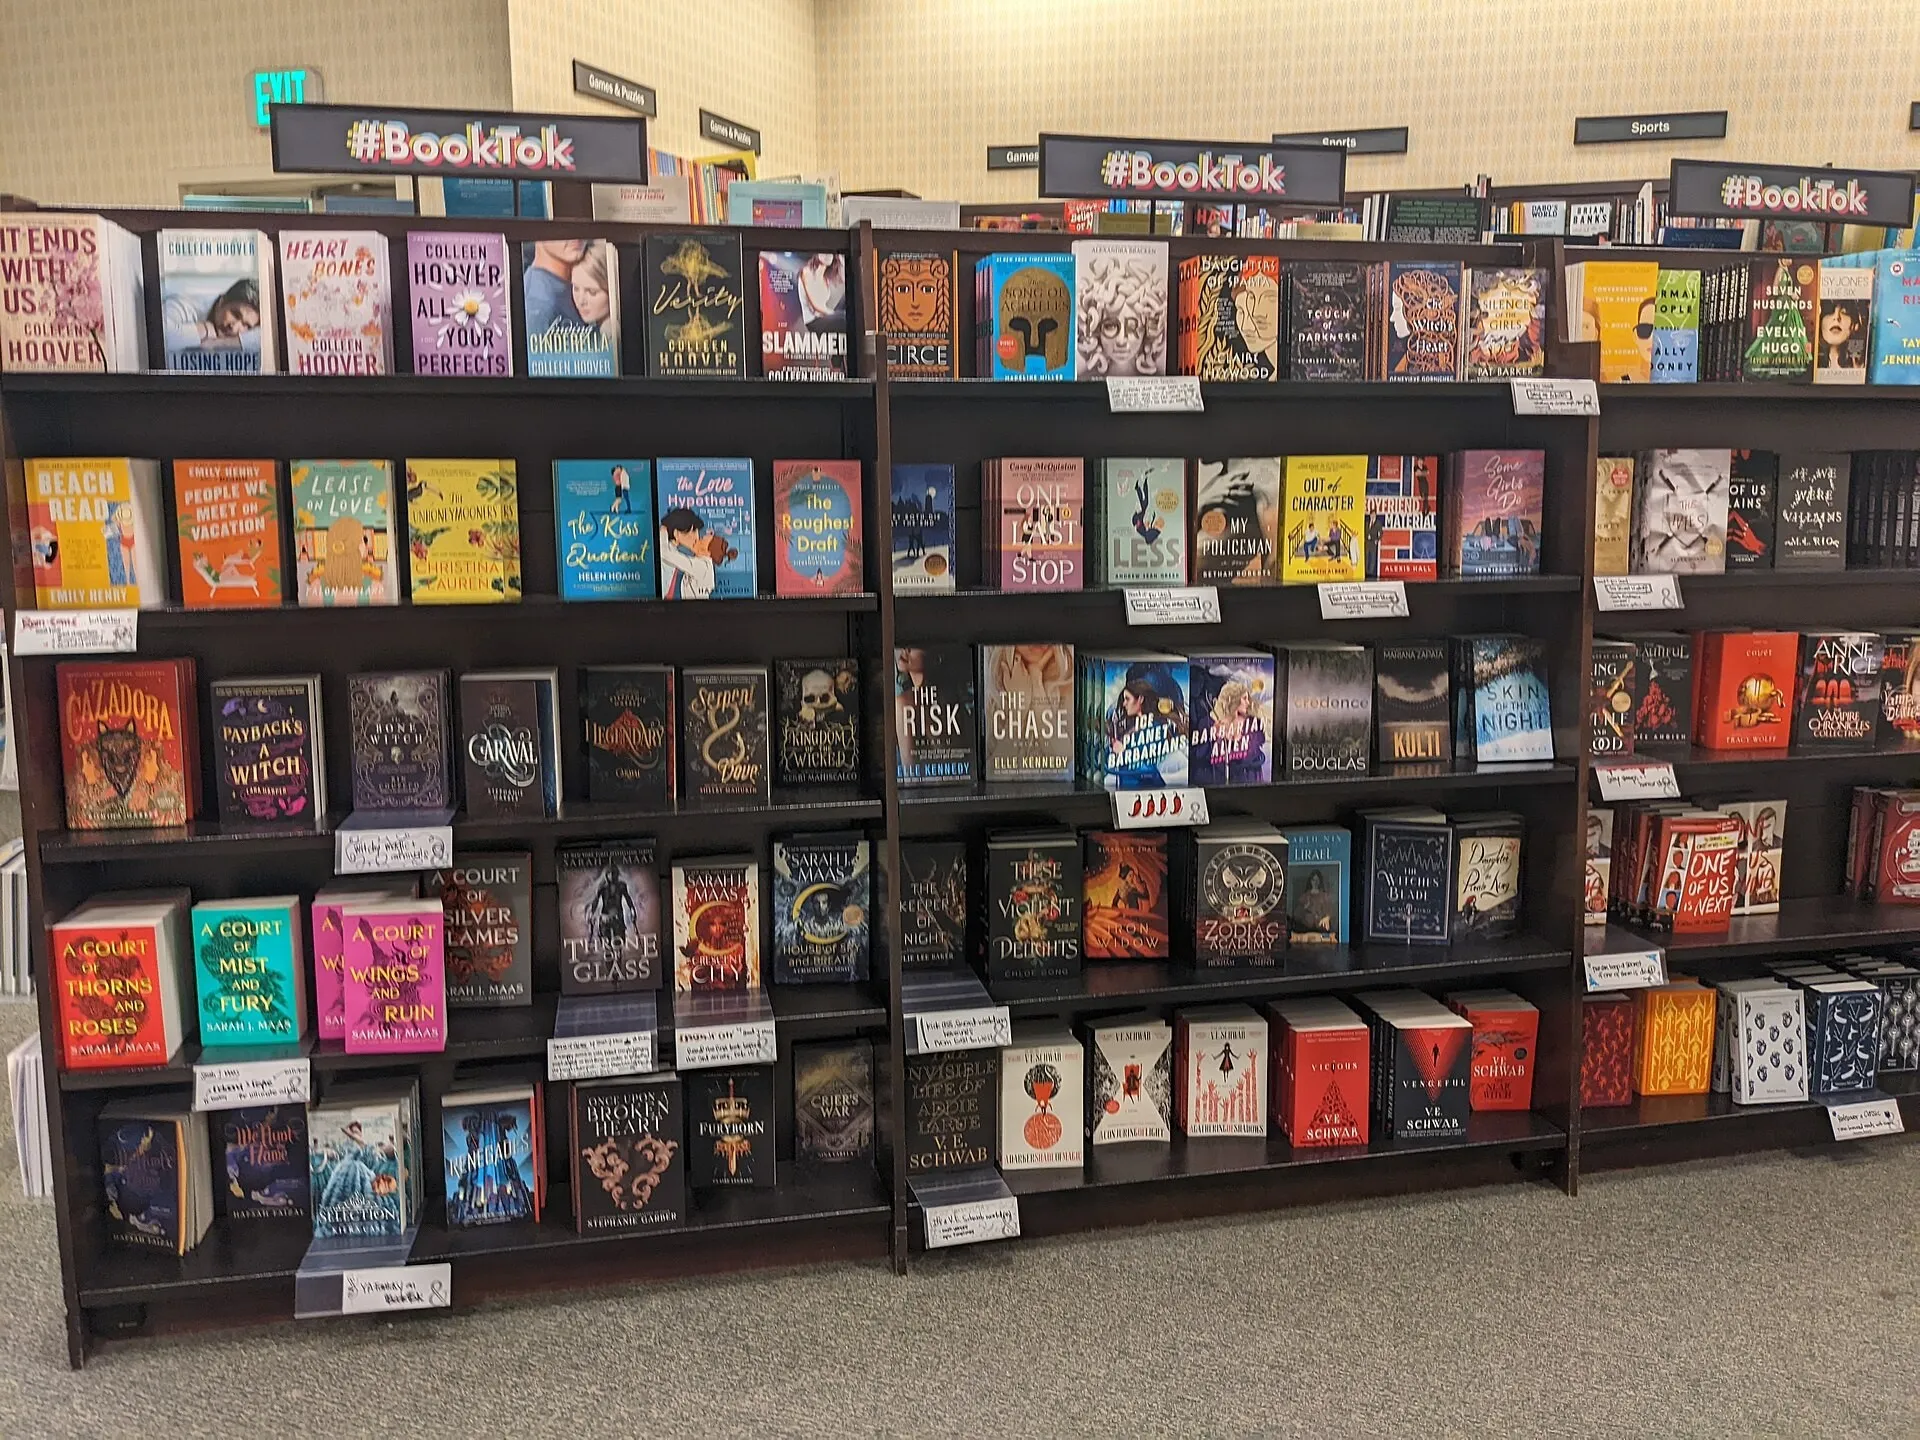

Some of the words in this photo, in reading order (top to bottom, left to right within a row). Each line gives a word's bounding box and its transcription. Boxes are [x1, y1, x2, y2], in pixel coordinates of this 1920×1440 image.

[589, 74, 613, 94] Games
[614, 85, 621, 98] &
[621, 85, 645, 106] Puzzles
[709, 119, 728, 138] Games
[728, 130, 733, 140] &
[1631, 119, 1670, 134] Sports
[347, 120, 576, 170] #BookTok
[1006, 151, 1039, 164] Games
[1101, 150, 1286, 194] #BookTok
[1721, 175, 1869, 215] #BookTok
[0, 228, 19, 254] IT
[28, 228, 97, 255] ENDS
[286, 239, 349, 261] HEART
[425, 244, 487, 260] COLLEEN
[1, 258, 67, 285] WITH
[314, 259, 376, 279] BONES
[414, 263, 502, 287] HOOVER
[1202, 259, 1276, 273] DAUGHTERS
[1766, 285, 1802, 296] SEVEN
[3, 289, 37, 315] US
[417, 298, 451, 319] ALL
[652, 283, 743, 320] Verity
[1483, 299, 1529, 310] SILENCE
[1753, 299, 1813, 310] HUSBANDS
[1489, 320, 1522, 331] GIRLS
[1756, 326, 1806, 337] EVELYN
[312, 338, 363, 353] COLLEEN
[446, 328, 495, 349] YOUR
[762, 332, 848, 356] SLAMMED
[1761, 342, 1800, 354] HUGO
[173, 353, 221, 371] LOSING
[226, 353, 259, 371] HOPE
[297, 353, 378, 375] HOOVER
[418, 354, 506, 375] PERFECTS
[531, 360, 572, 375] COLLEEN
[574, 359, 611, 376] HOOVER
[1477, 367, 1494, 377] PAT
[1497, 366, 1533, 376] BARKER
[188, 467, 220, 478] EMILY
[224, 467, 260, 477] HENRY
[38, 470, 115, 496] BEACH
[311, 475, 373, 496] LEASE
[1303, 477, 1326, 494] OUT
[1729, 484, 1745, 496] OF
[1752, 484, 1766, 496] US
[184, 483, 240, 505] PEOPLE
[245, 480, 268, 495] WE
[668, 494, 744, 509] Hypothesis
[1016, 484, 1070, 508] ONE
[49, 497, 109, 522] READ
[307, 499, 323, 512] ON
[329, 495, 375, 517] LOVE
[807, 494, 832, 510] The
[1292, 495, 1355, 512] CHARACTER
[196, 503, 237, 523] MEET
[242, 503, 259, 516] ON
[1385, 513, 1436, 529] MATERIAL
[190, 516, 266, 541] VACATION
[782, 512, 854, 535] Roughest
[1230, 517, 1249, 535] MY
[1011, 520, 1078, 546] LAST
[797, 535, 838, 553] Draft
[1203, 538, 1272, 557] POLICEMAN
[1113, 538, 1181, 569] LESS
[415, 560, 499, 575] CHRISTINA
[578, 572, 607, 582] HELEN
[609, 571, 641, 581] HOANG
[1012, 556, 1075, 585] STOP
[1385, 565, 1411, 573] ALEXIS
[1413, 565, 1432, 573] HALL
[426, 577, 490, 591] LAUREN
[50, 588, 86, 603] EMILY
[89, 587, 127, 602] HENRY
[1814, 640, 1874, 659] ANNE
[1832, 656, 1878, 677] RICE
[912, 686, 937, 706] THE
[1000, 691, 1025, 710] THE
[1487, 684, 1540, 701] SKIN
[66, 680, 176, 741] CAZADORA
[1816, 709, 1860, 722] VAMPIRE
[376, 723, 418, 733] BONE
[904, 703, 961, 737] RISK
[993, 710, 1069, 740] CHASE
[1481, 711, 1548, 732] NIGHT
[222, 718, 304, 744] PAYBACK'S
[1123, 725, 1170, 750] PLANET
[1191, 718, 1268, 746] BARBARIAN
[1726, 735, 1750, 744] TRACY
[1752, 734, 1777, 744] WOLFF
[1813, 729, 1864, 738] COLLECTION
[1107, 735, 1188, 769] BARBARIANS
[1393, 731, 1441, 758] KULTI
[230, 756, 302, 786] WITCH
[898, 762, 921, 777] ELLE
[924, 762, 970, 776] KENNEDY
[994, 757, 1018, 769] ELLE
[1022, 756, 1068, 769] KENNEDY
[1292, 757, 1366, 772] DOUGLAS
[1294, 847, 1333, 861] LIRAEL
[1690, 849, 1733, 878] ONE
[431, 871, 446, 886] A
[452, 867, 520, 885] COURT
[1688, 878, 1706, 895] OF
[1709, 876, 1729, 894] US
[693, 886, 739, 902] MAAS
[1693, 894, 1734, 917] NEXT
[201, 923, 214, 936] A
[219, 920, 283, 937] COURT
[352, 927, 365, 942] A
[372, 925, 436, 942] COURT
[1204, 920, 1279, 941] ZODIAC
[63, 942, 76, 958] A
[81, 939, 148, 957] COURT
[233, 941, 252, 953] OF
[563, 933, 658, 964] THRONE
[1096, 936, 1160, 949] WIDOW
[410, 946, 430, 959] OF
[81, 963, 99, 974] OF
[219, 957, 269, 975] MIST
[350, 965, 419, 983] WINGS
[573, 959, 651, 983] GLASS
[64, 978, 152, 997] THORNS
[231, 979, 260, 991] AND
[372, 988, 400, 1000] AND
[114, 1000, 145, 1013] AND
[219, 994, 273, 1014] FURY
[385, 1004, 435, 1023] RUIN
[69, 1017, 138, 1037] ROSES
[206, 1022, 245, 1033] SARAH
[258, 1020, 291, 1031] MAAS
[1311, 1060, 1358, 1072] VICIOUS
[1473, 1064, 1525, 1078] SCHWAB
[1402, 1079, 1466, 1089] VENGEFUL
[587, 1100, 670, 1123] BROKEN
[819, 1105, 850, 1119] WAR
[595, 1119, 661, 1137] HEART
[699, 1120, 765, 1136] FURYBORN
[1306, 1127, 1358, 1139] SCHWAB
[1406, 1118, 1459, 1130] SCHWAB
[909, 1147, 988, 1169] SCHWAB
[318, 1207, 396, 1223] SELECTION
